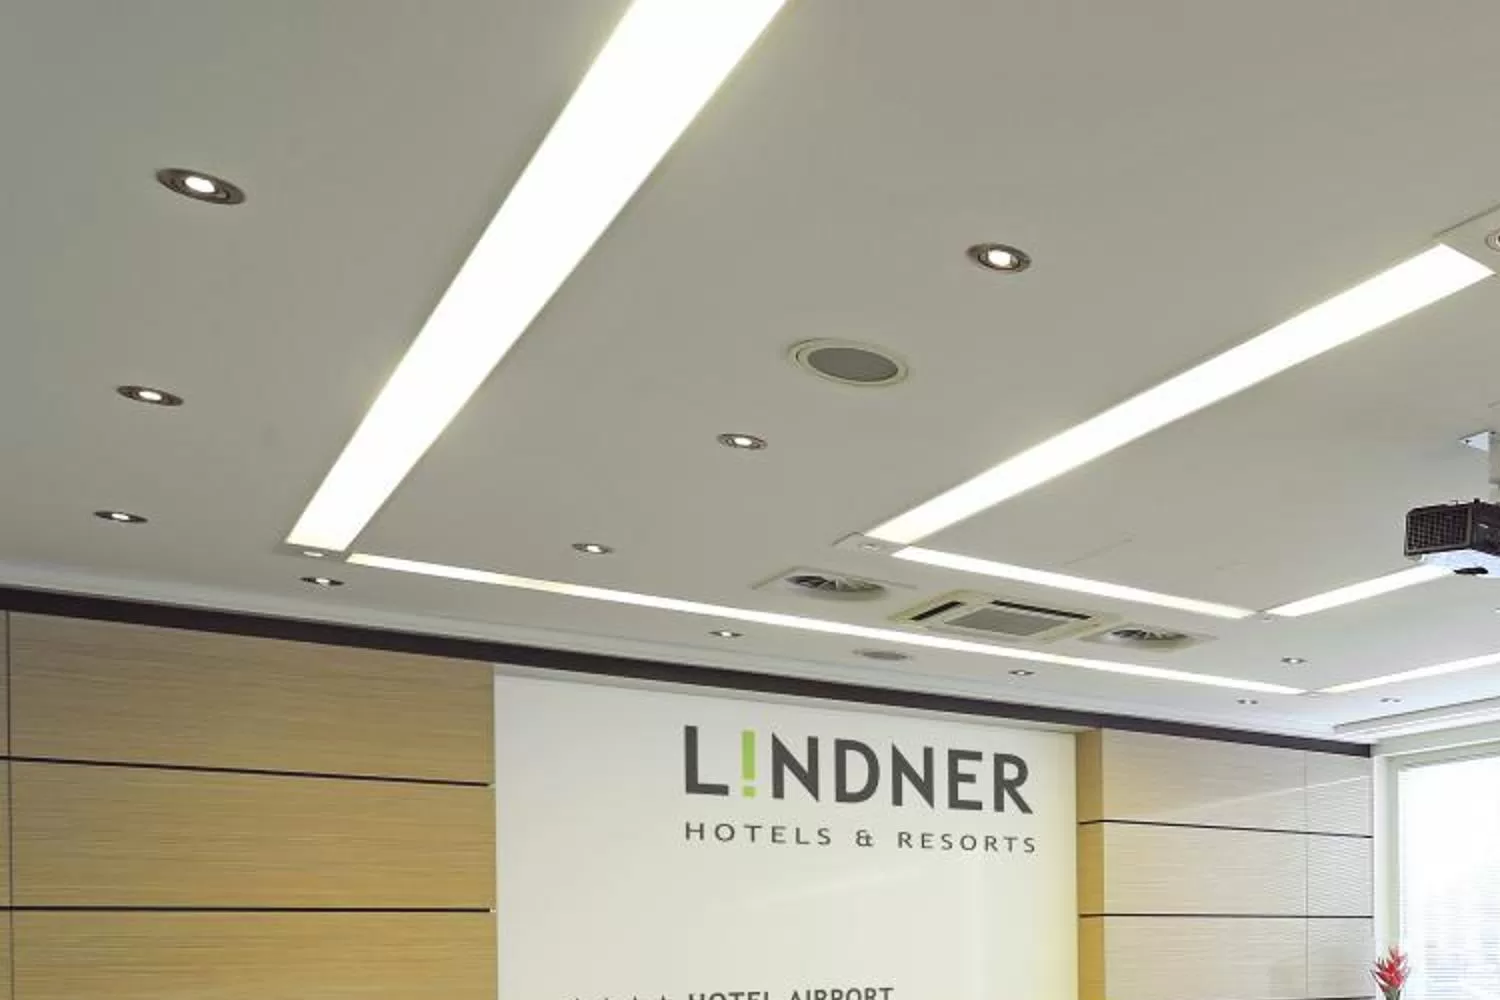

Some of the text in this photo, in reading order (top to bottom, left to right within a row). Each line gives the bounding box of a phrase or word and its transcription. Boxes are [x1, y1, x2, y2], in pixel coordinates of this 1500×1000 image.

[685, 821, 1036, 853] HOTELS & RESORTS
